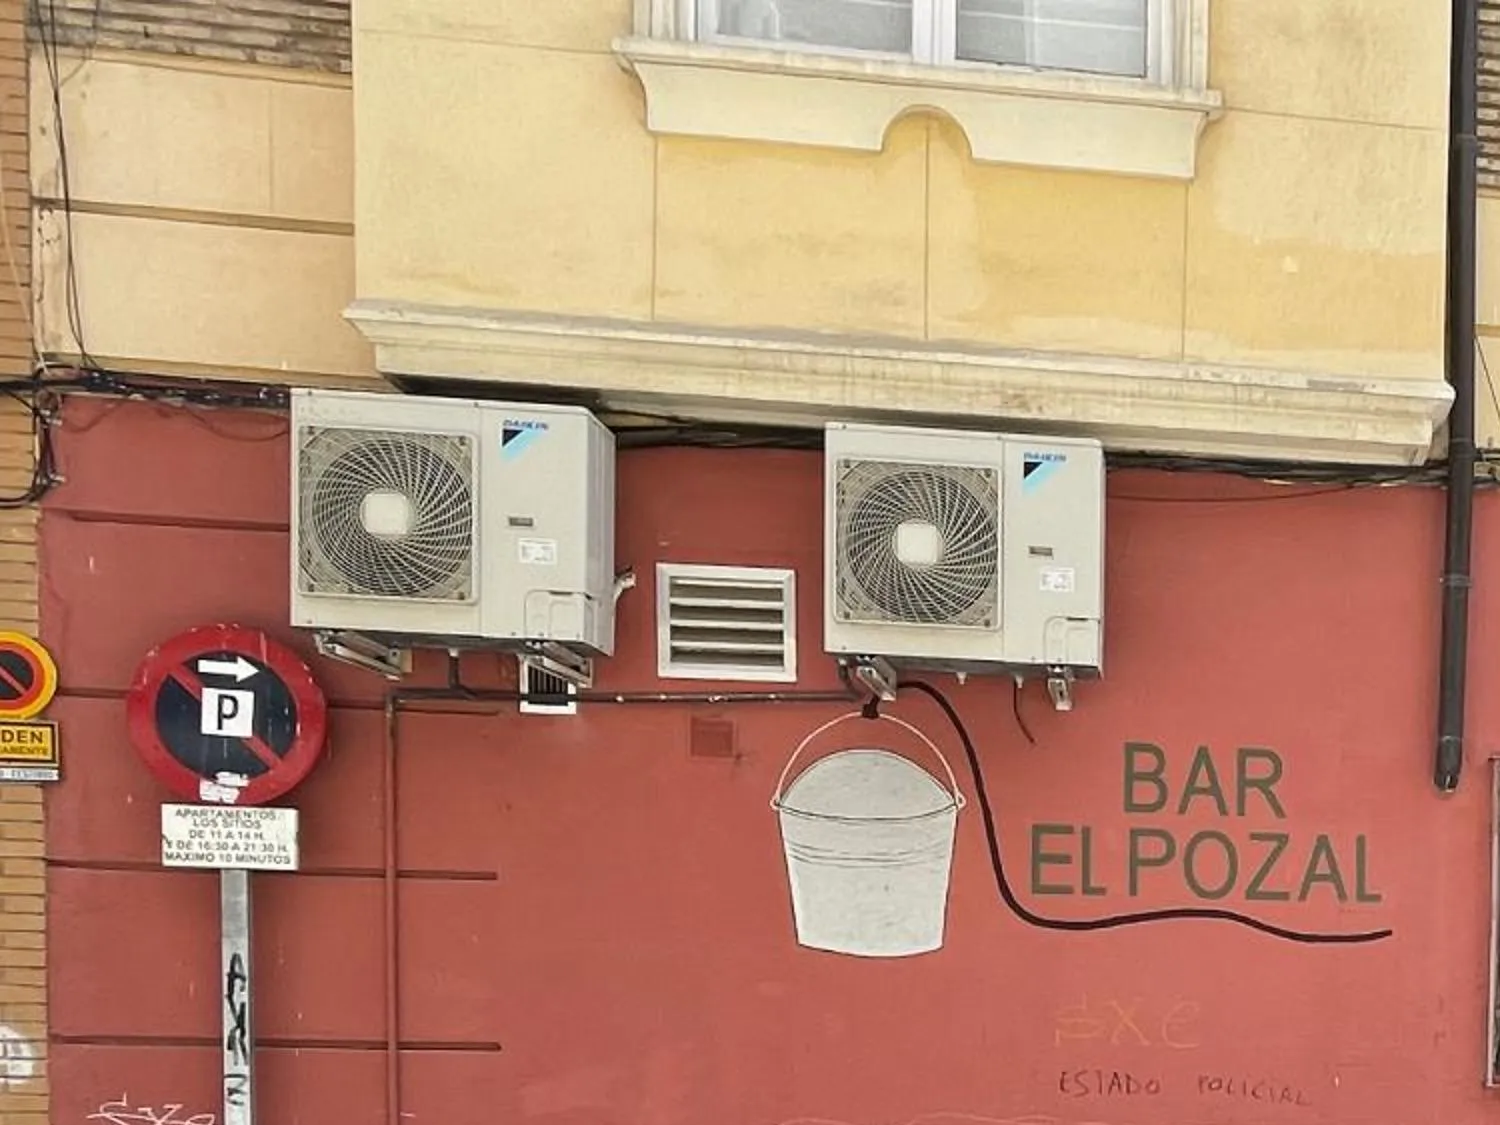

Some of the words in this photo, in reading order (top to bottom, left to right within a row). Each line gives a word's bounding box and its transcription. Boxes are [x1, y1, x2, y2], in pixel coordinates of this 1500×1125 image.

[217, 694, 239, 730] P
[1123, 742, 1286, 819] BAR
[175, 808, 277, 820] APARTAMENTOS
[192, 818, 218, 828] LOS
[222, 818, 262, 830] SITIOS
[189, 829, 205, 839] DE
[225, 831, 234, 840] A
[176, 840, 193, 851] DE
[231, 842, 240, 852] A
[235, 853, 291, 865] MINUTOS
[1031, 824, 1107, 896] EL
[1128, 828, 1382, 902] POZAL
[1059, 1069, 1161, 1097] ESTADO
[1199, 1074, 1312, 1106] POLICIAL
